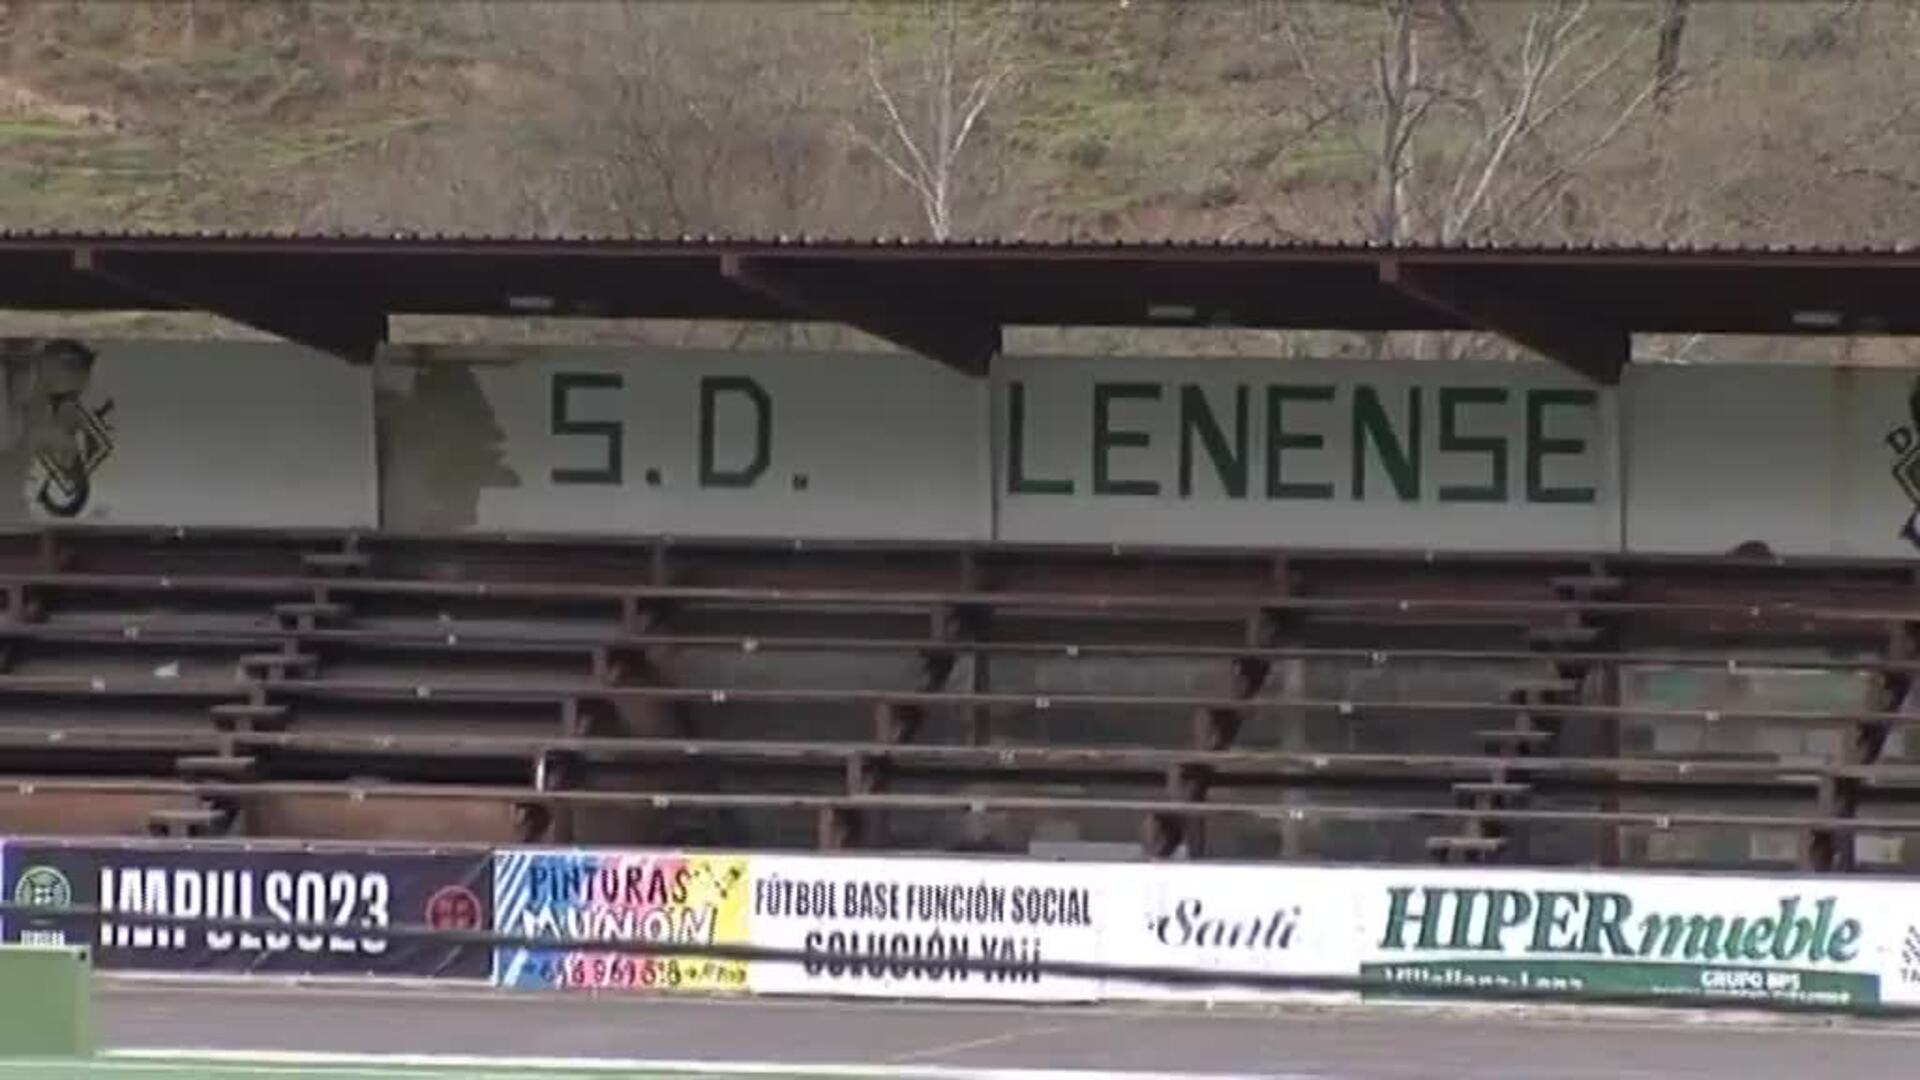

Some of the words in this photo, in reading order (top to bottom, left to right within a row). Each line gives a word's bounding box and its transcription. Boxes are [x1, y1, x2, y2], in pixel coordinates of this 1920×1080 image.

[1008, 382, 1597, 504] LENENSE
[100, 868, 389, 953] IMPULSO23
[530, 865, 690, 905] PINTURAS
[755, 872, 836, 918] FÚTBOL
[844, 880, 900, 922] BASE
[906, 879, 1005, 923] FUNCIÓN
[1011, 885, 1092, 927] SOCIAL
[803, 927, 968, 982] SOLUCIÓN
